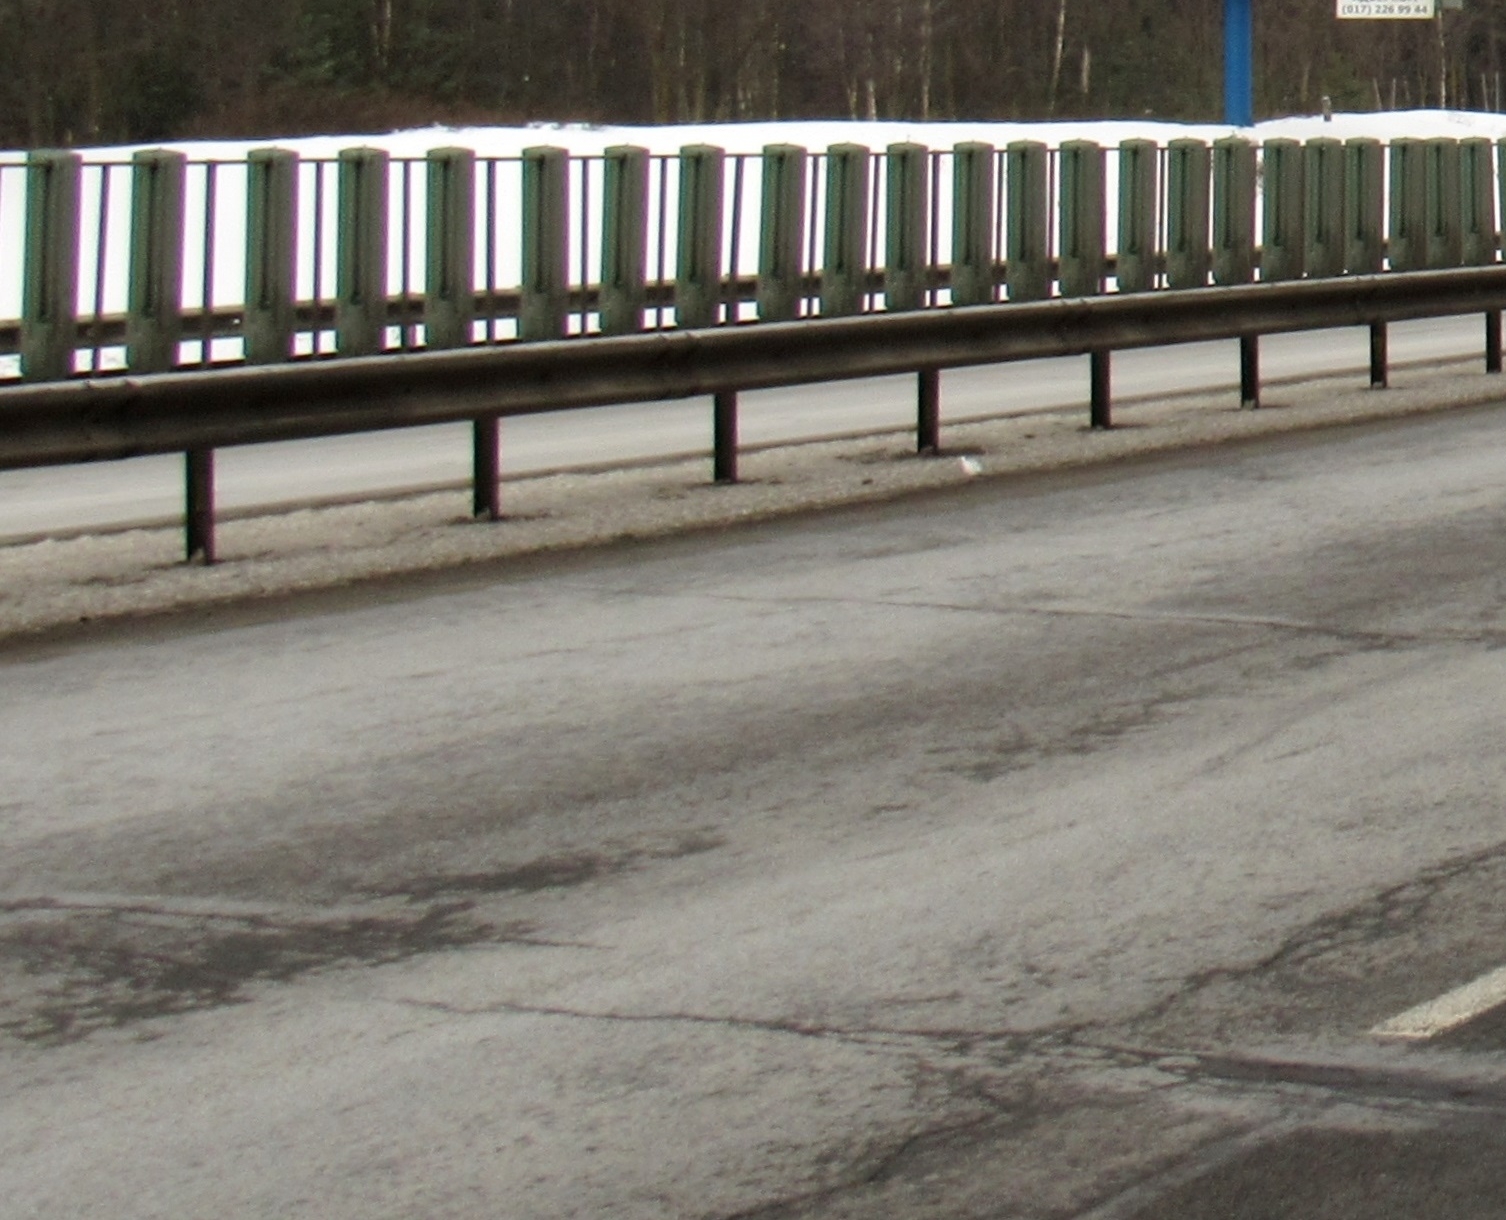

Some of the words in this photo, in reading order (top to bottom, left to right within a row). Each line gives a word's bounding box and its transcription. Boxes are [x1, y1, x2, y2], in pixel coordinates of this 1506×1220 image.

[1342, 5, 1372, 15] (017)
[1375, 5, 1395, 15] 226
[1414, 5, 1428, 14] 44
